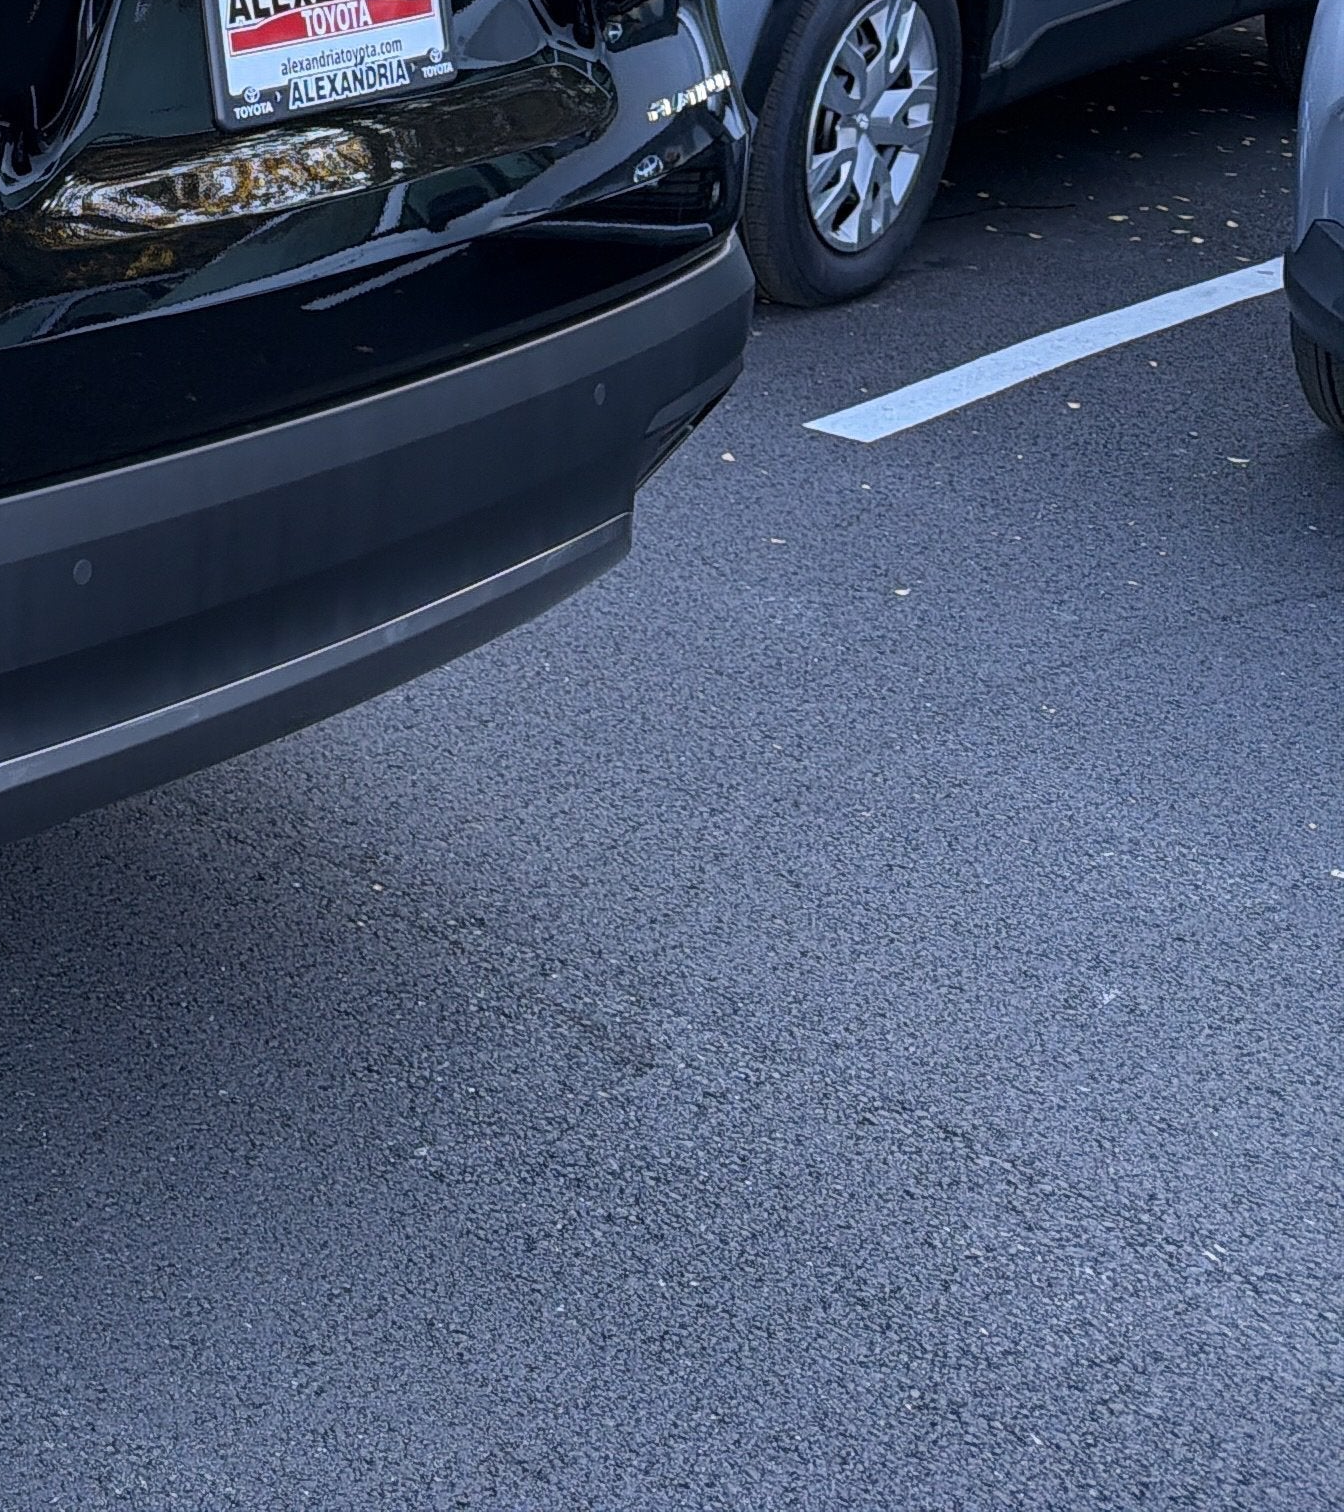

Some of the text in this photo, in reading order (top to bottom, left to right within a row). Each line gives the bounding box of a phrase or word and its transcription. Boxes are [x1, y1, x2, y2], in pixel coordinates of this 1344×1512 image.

[301, 0, 373, 38] TOYOTA
[280, 37, 403, 76] alexandriatoyota.com
[233, 59, 454, 120] TOYOTA ALEXANDRIA TOYOTA
